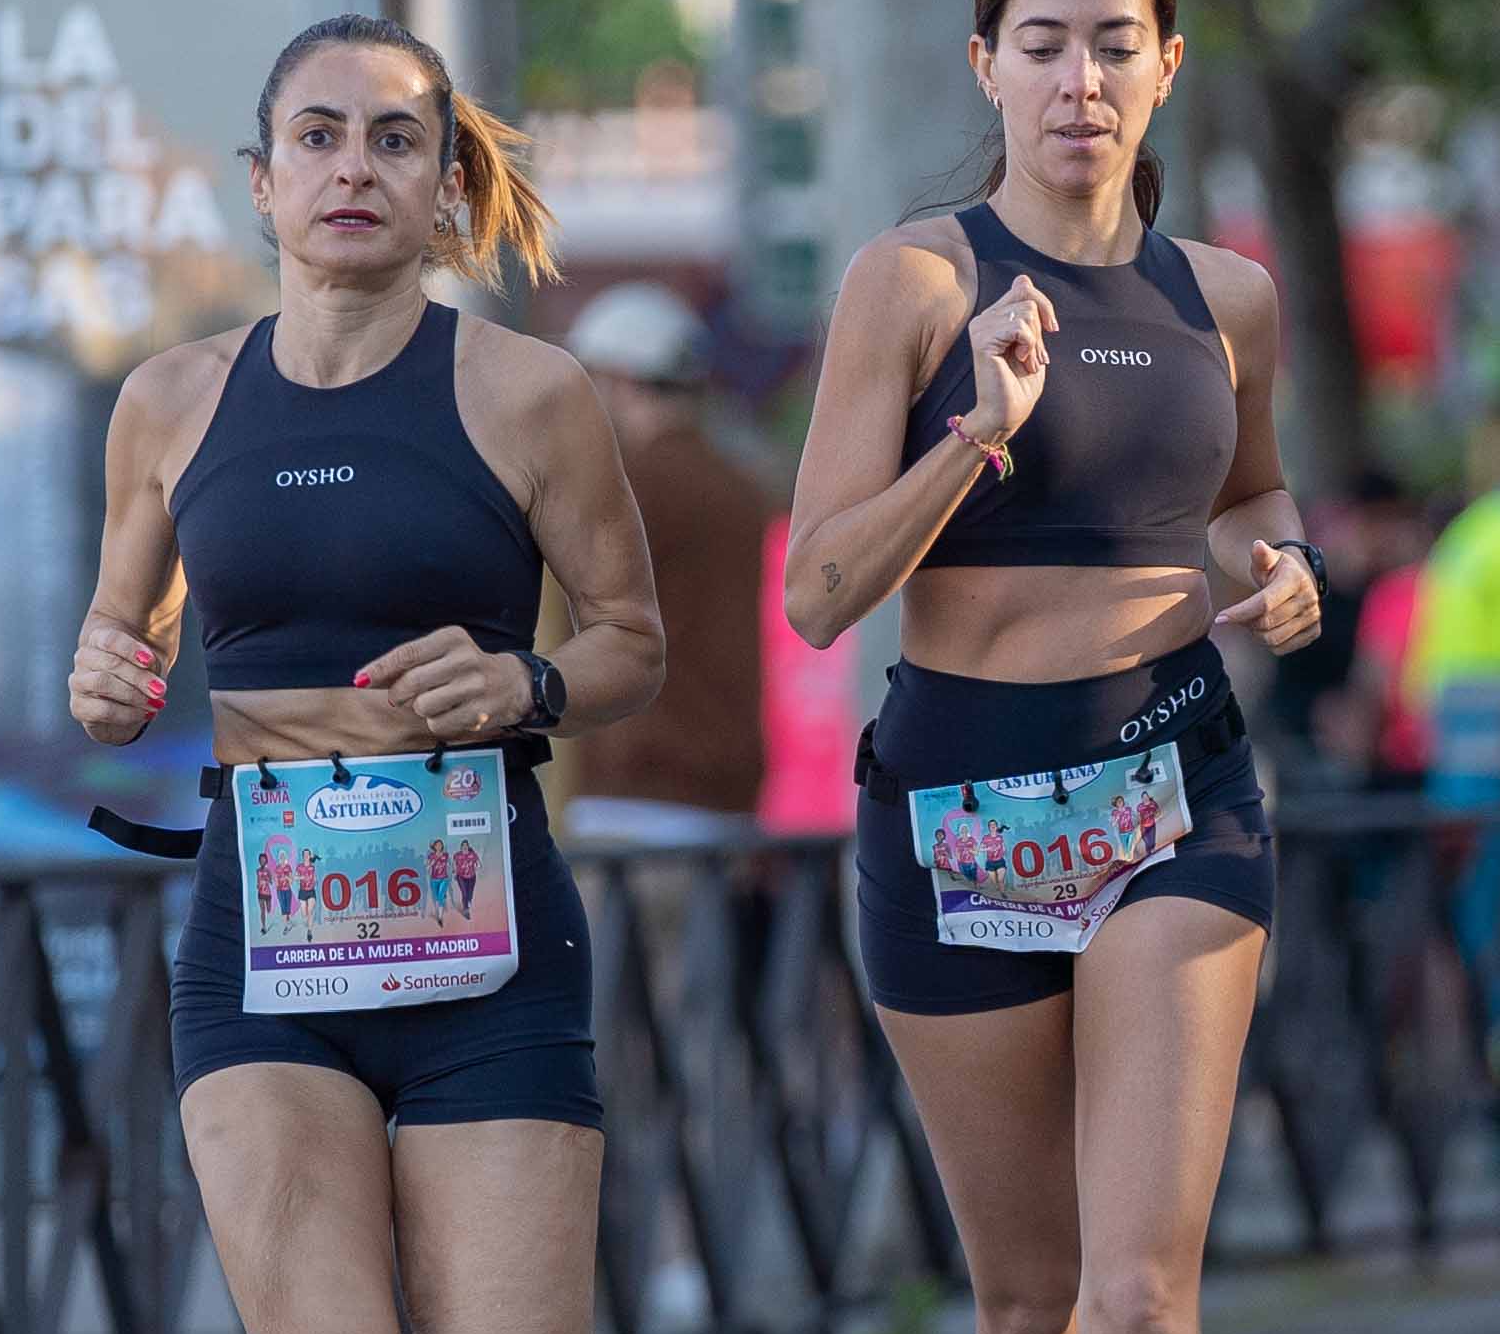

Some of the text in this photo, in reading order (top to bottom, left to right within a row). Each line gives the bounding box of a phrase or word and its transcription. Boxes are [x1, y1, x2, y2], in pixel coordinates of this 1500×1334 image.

[1080, 348, 1152, 366] OYSHO
[276, 465, 354, 487] OYSHO
[1120, 676, 1205, 743] OYSHO
[451, 769, 475, 788] 20
[997, 765, 1098, 791] ASTURANA
[251, 790, 290, 805] SUMA
[313, 796, 415, 820] ASTURIANA
[1011, 828, 1114, 879] 016
[321, 868, 422, 911] 016
[1053, 883, 1078, 901] 29
[1028, 903, 1046, 913] DE
[1047, 902, 1064, 917] LA
[356, 921, 381, 940] 32
[970, 920, 1054, 939] OYSHO
[276, 938, 479, 964] CARRERA DE LA MUJER MADRID
[275, 971, 485, 998] OYSHO Santander
